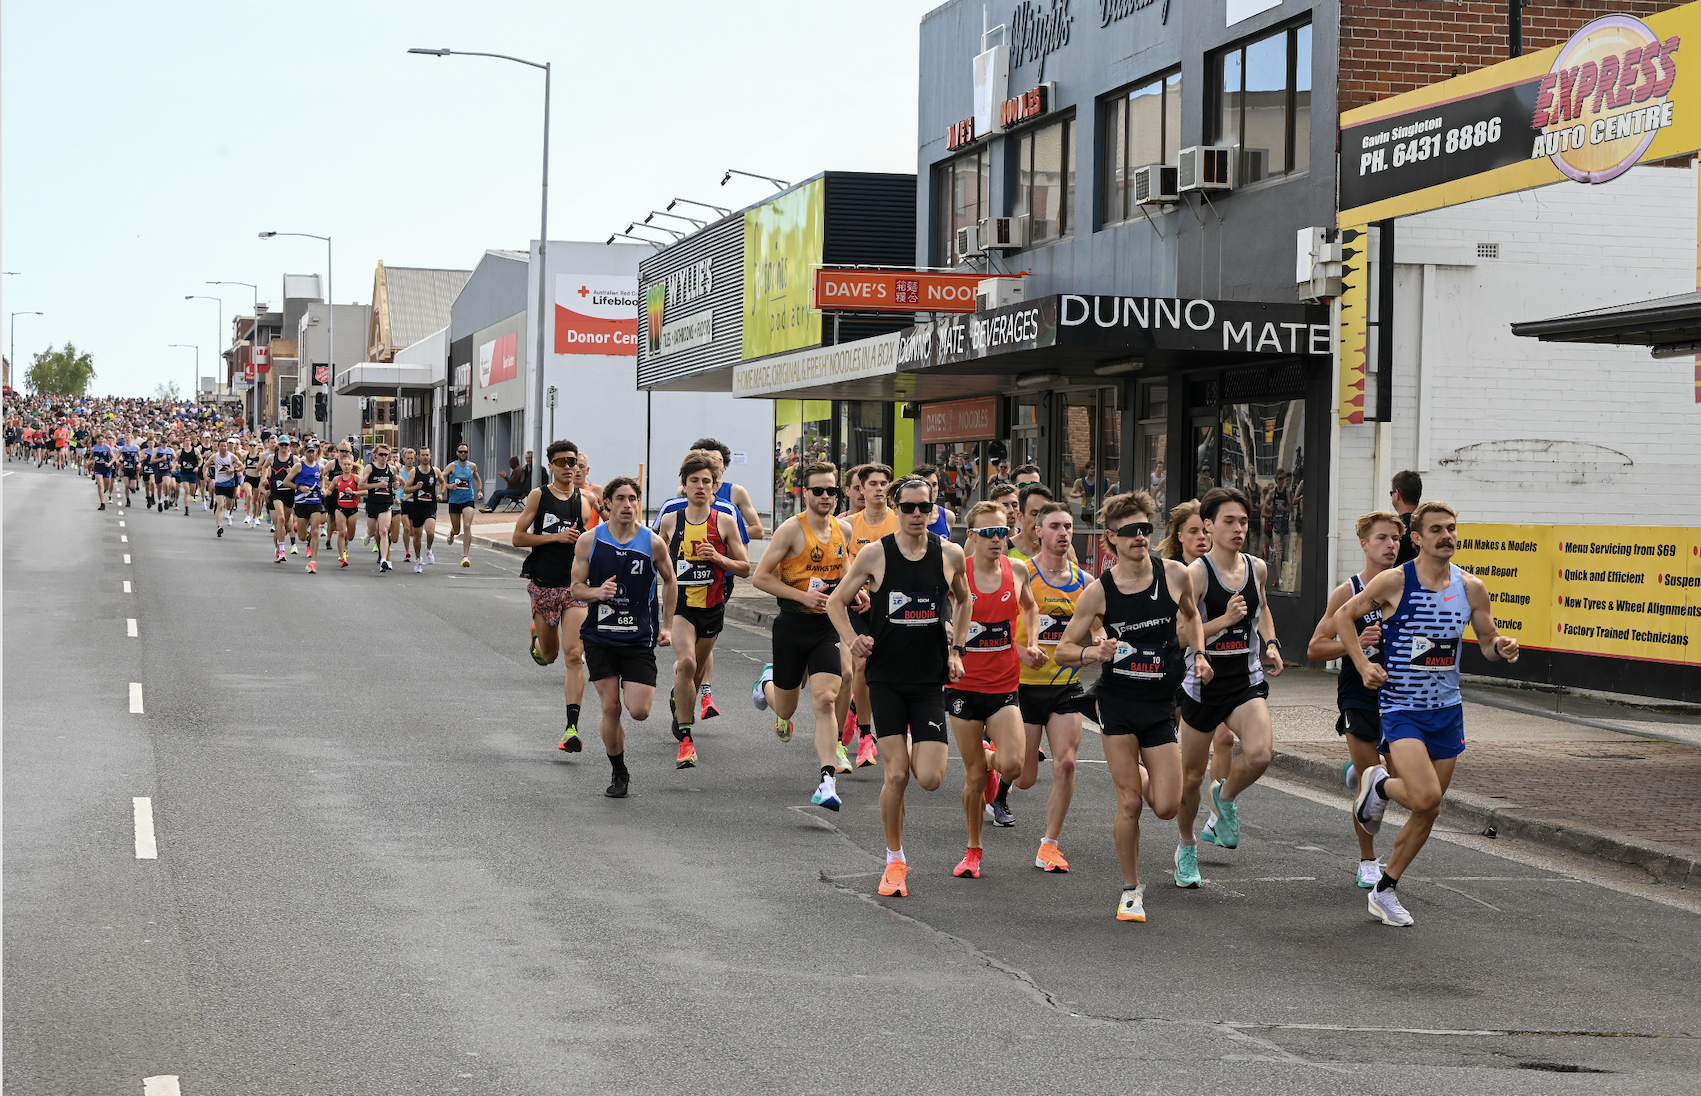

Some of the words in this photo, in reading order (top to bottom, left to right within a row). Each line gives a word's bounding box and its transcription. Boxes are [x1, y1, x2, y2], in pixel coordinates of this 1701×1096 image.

[1531, 35, 1681, 128] EXPRESS
[1362, 130, 1390, 149] Gavin
[1392, 117, 1443, 141] Singleton
[1531, 124, 1587, 160] AUTO
[1589, 101, 1674, 145] CENTRE
[1360, 149, 1388, 176] PH.
[1392, 133, 1442, 168] 6431
[1445, 116, 1502, 154] 8886
[669, 258, 714, 307] WYLLIE'S
[825, 281, 887, 298] DAVE'S
[769, 303, 810, 339] podiatry
[1060, 294, 1216, 331] DUNNO
[1223, 320, 1331, 355] MATE
[567, 329, 610, 344] Donor
[898, 332, 932, 364] DUNNO
[938, 325, 966, 356] MATE
[972, 308, 1039, 350] BEVERAGES
[772, 361, 801, 385] ORIGINAL
[801, 360, 807, 380] &
[830, 348, 861, 376] NOODLES
[861, 346, 870, 369] IN
[870, 344, 876, 367] A
[877, 341, 895, 366] BOX
[926, 413, 946, 432] DAVE'S
[959, 409, 988, 430] NOODLES
[1463, 539, 1473, 549] All
[1474, 539, 1499, 551] Makes
[1501, 541, 1506, 551] &
[1508, 541, 1538, 552] Models
[1565, 542, 1588, 553] Menu
[1590, 543, 1632, 556] Servicing
[1634, 544, 1655, 555] from
[1657, 544, 1676, 557] $69
[630, 560, 644, 575] 21
[693, 570, 711, 579] 1397
[1476, 565, 1490, 576] and
[1491, 566, 1518, 577] Report
[1564, 569, 1588, 581] Quick
[1589, 571, 1606, 582] and
[1607, 571, 1645, 584] Efficient
[1664, 574, 1701, 588] Suspen
[931, 602, 936, 610] 5
[1500, 592, 1530, 605] Change
[1564, 596, 1582, 608] New
[1583, 597, 1606, 610] Tyres
[1608, 601, 1614, 610] &
[1616, 600, 1645, 613] Wheel
[1647, 602, 1701, 617] Alignments
[617, 616, 634, 625] 682
[905, 610, 935, 620] BOUDIN
[1120, 617, 1171, 633] CROMARTY
[1003, 630, 1008, 638] 9
[1564, 623, 1594, 638] Factory
[1596, 626, 1630, 640] Trained
[1631, 629, 1689, 646] Technicians
[979, 637, 1008, 647] PARKER
[1216, 641, 1248, 651] CARROLL
[1131, 662, 1160, 673] BAILEY
[1152, 656, 1161, 664] 10
[1425, 657, 1454, 666] RAYNER
